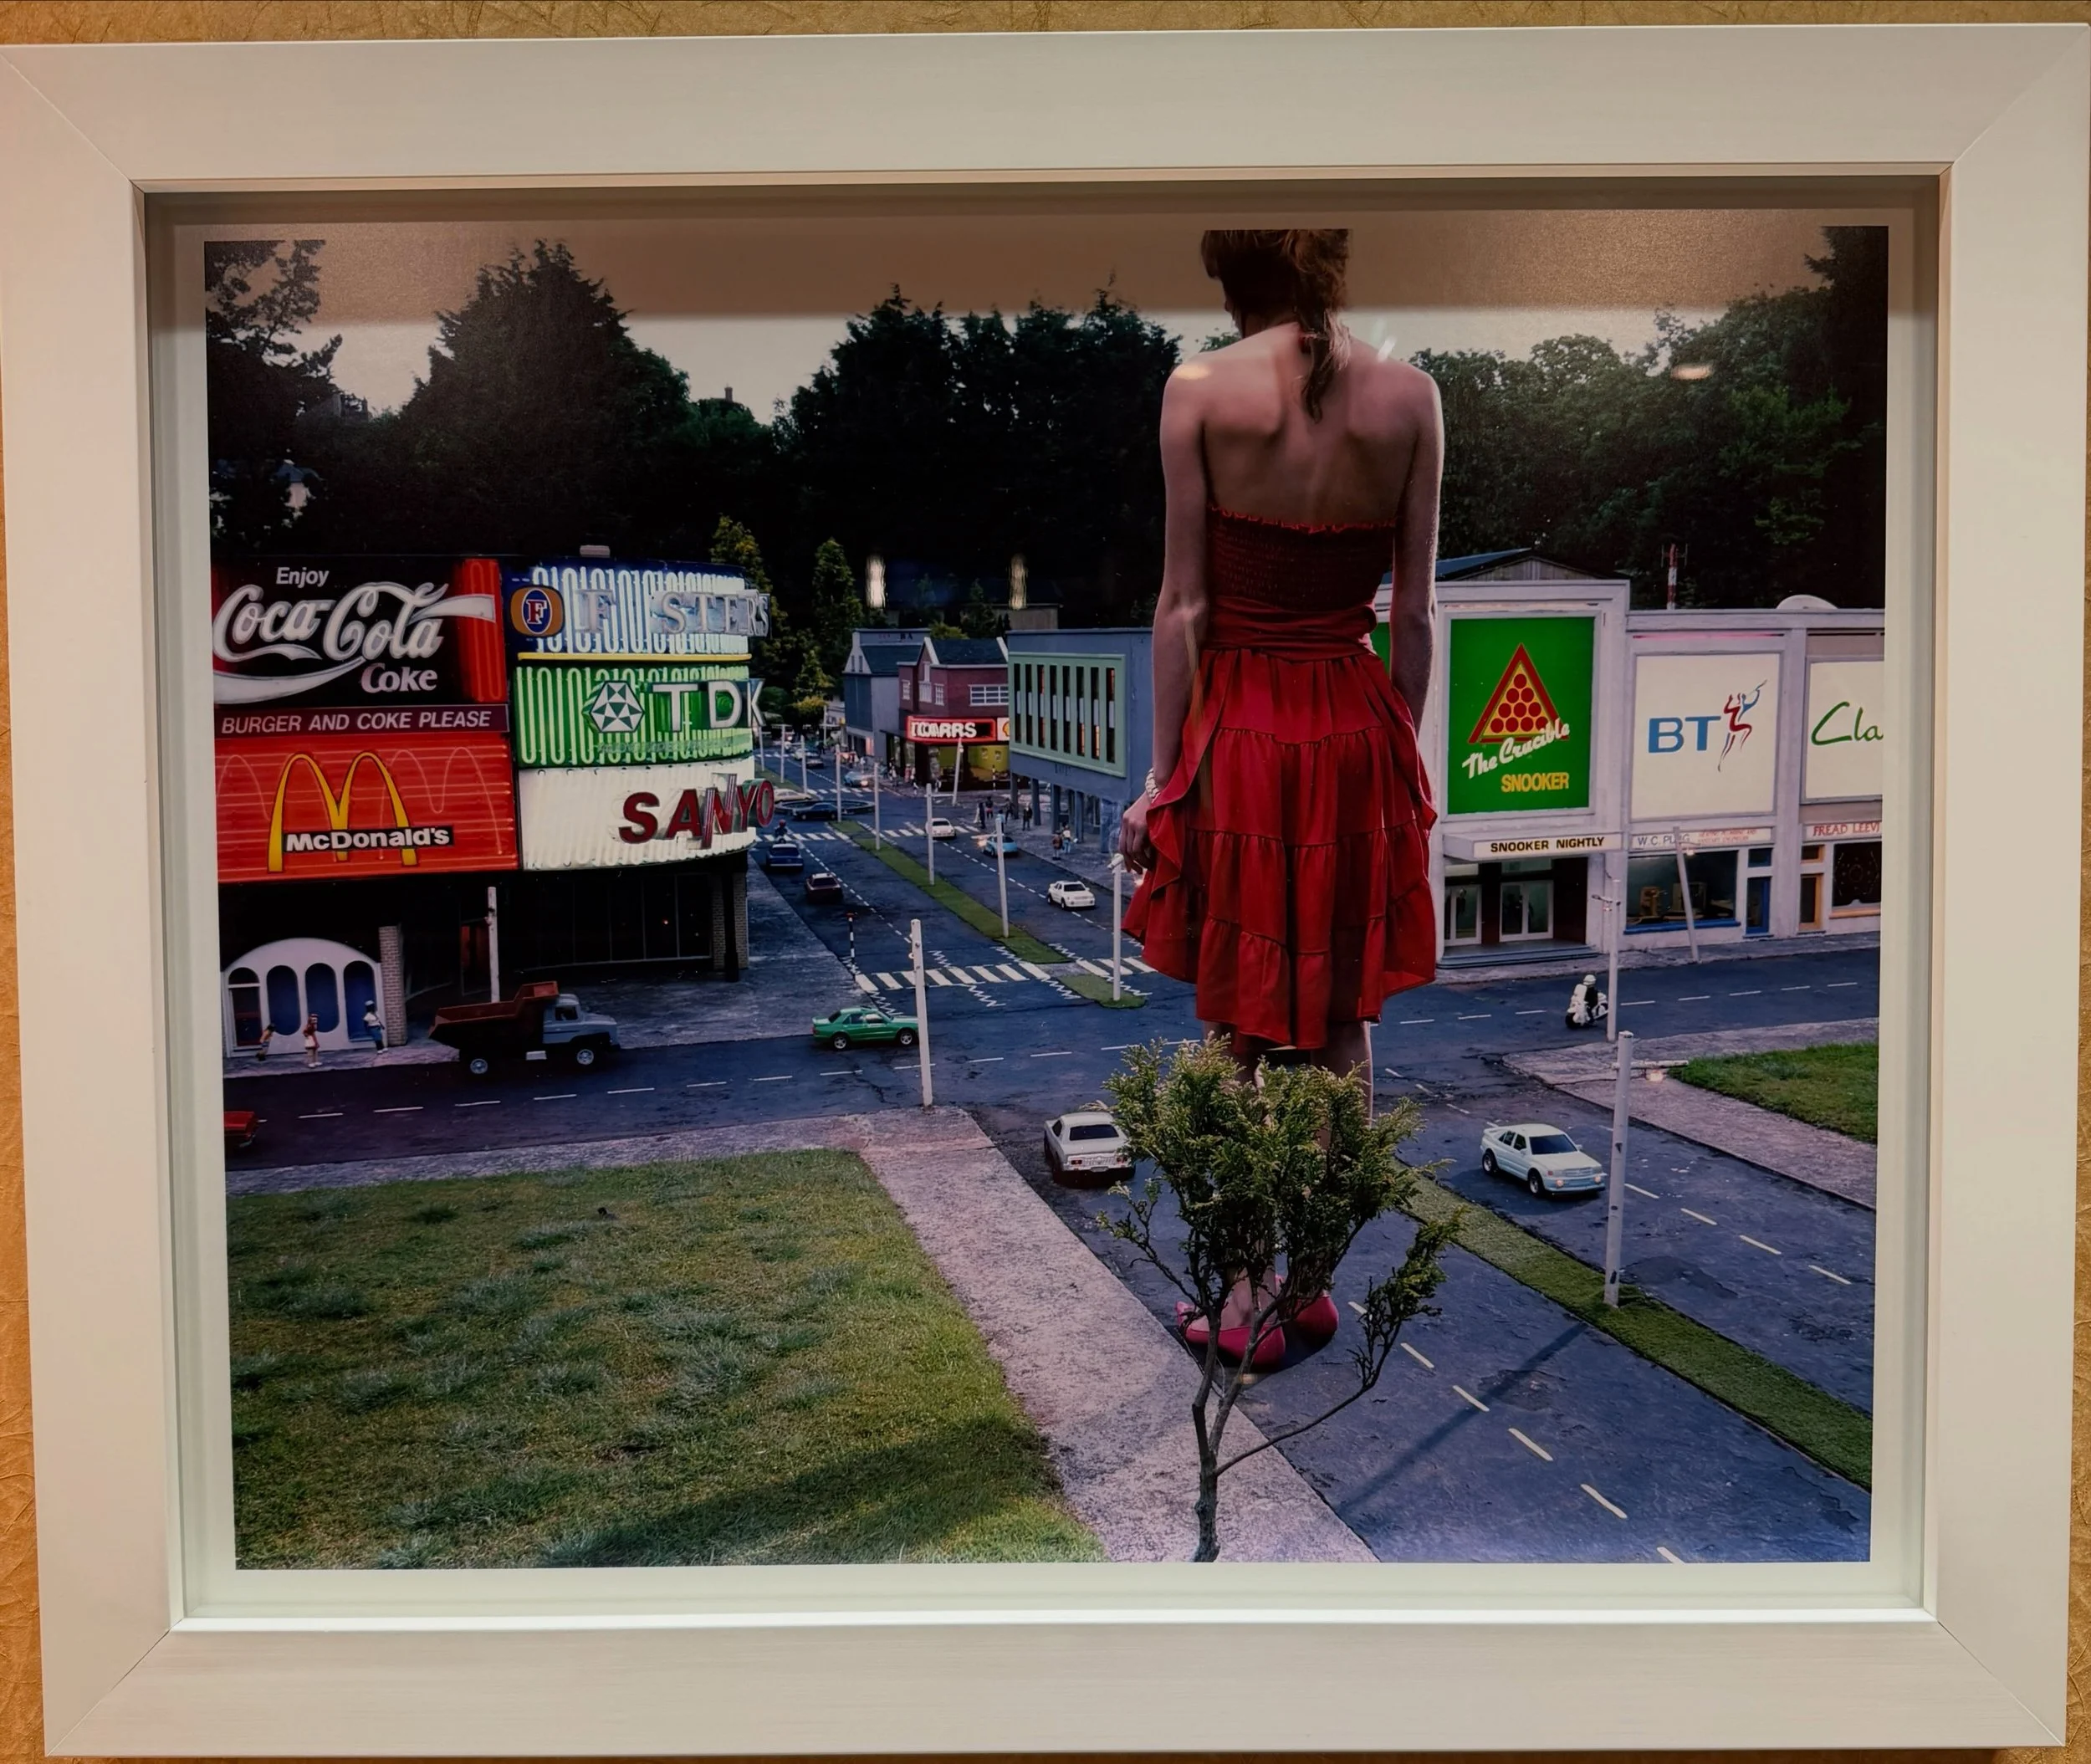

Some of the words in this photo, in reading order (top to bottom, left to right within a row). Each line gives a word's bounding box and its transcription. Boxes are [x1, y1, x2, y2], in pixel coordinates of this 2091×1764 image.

[276, 567, 330, 588] Enjoy
[526, 599, 548, 625] F
[361, 663, 437, 693] Coke
[652, 678, 765, 733] TDK
[222, 715, 301, 734] BURGER
[309, 714, 350, 731] AND
[357, 712, 412, 730] COKE
[419, 710, 491, 728] PLEASE
[1648, 716, 1721, 753] BT
[1811, 701, 1883, 745] Cla
[1462, 752, 1498, 779] The
[1499, 717, 1570, 764] Crucible
[1501, 772, 1569, 792] SNOOKER
[619, 773, 775, 849] SANYO
[286, 827, 450, 851] McDonald's
[1490, 841, 1549, 852] SNOOKER
[1556, 836, 1604, 849] NIGHTLY
